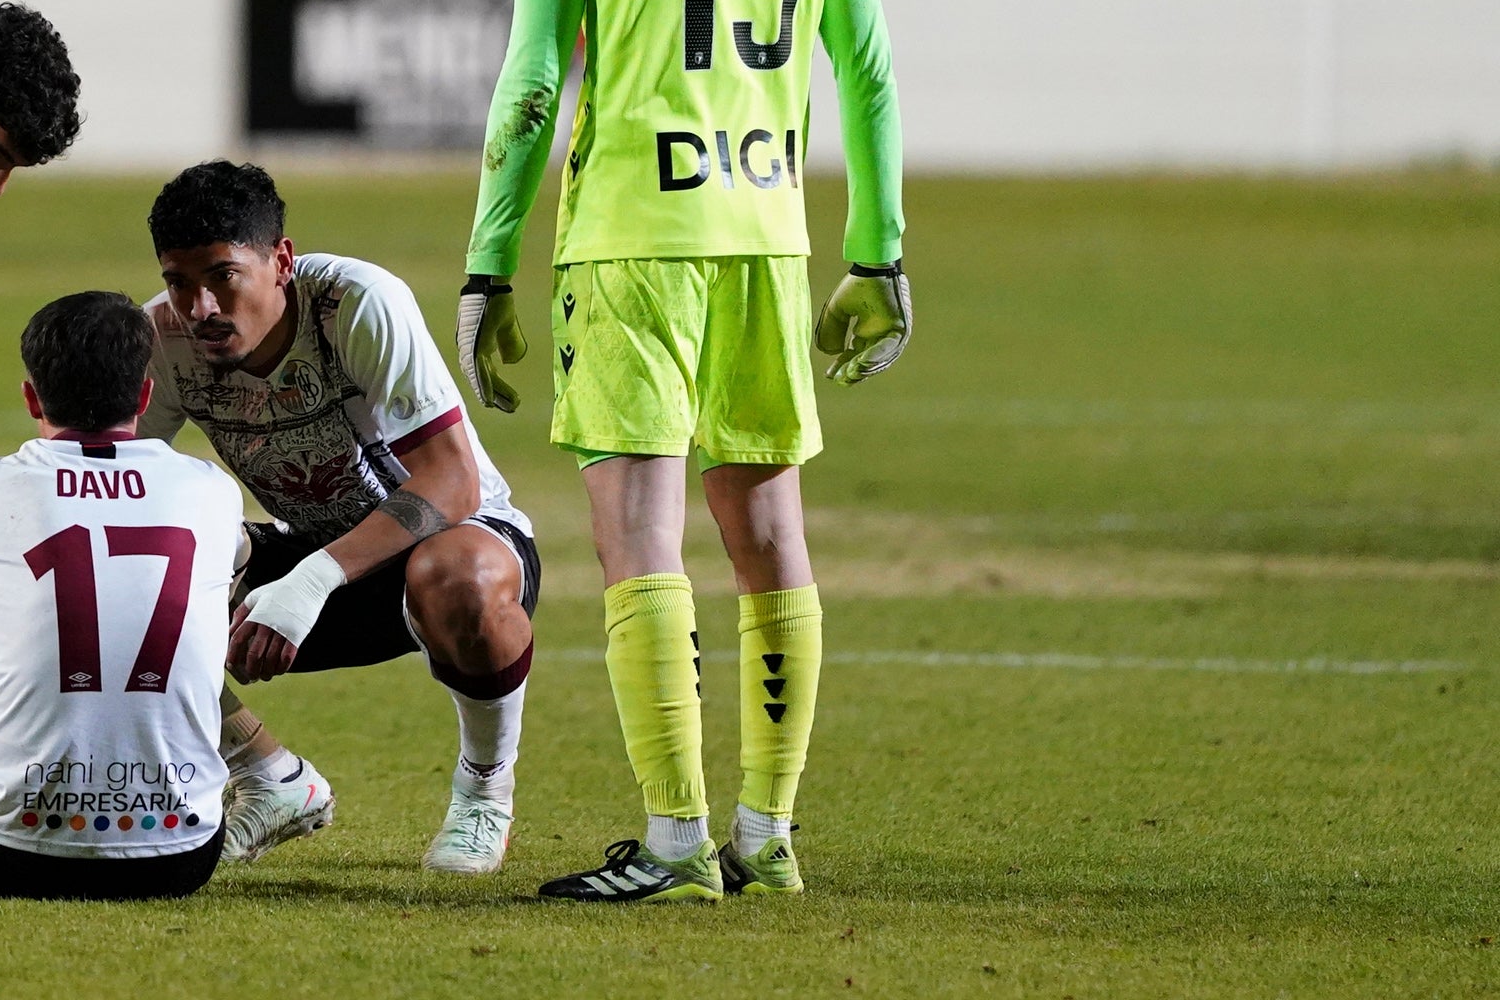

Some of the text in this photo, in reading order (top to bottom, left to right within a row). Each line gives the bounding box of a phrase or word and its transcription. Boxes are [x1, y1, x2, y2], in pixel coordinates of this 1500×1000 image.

[656, 128, 798, 192] DIGI
[56, 468, 146, 499] DAVO
[22, 524, 197, 693] 17
[24, 754, 196, 791] nani grupo
[23, 791, 193, 812] EMPRESARIA
